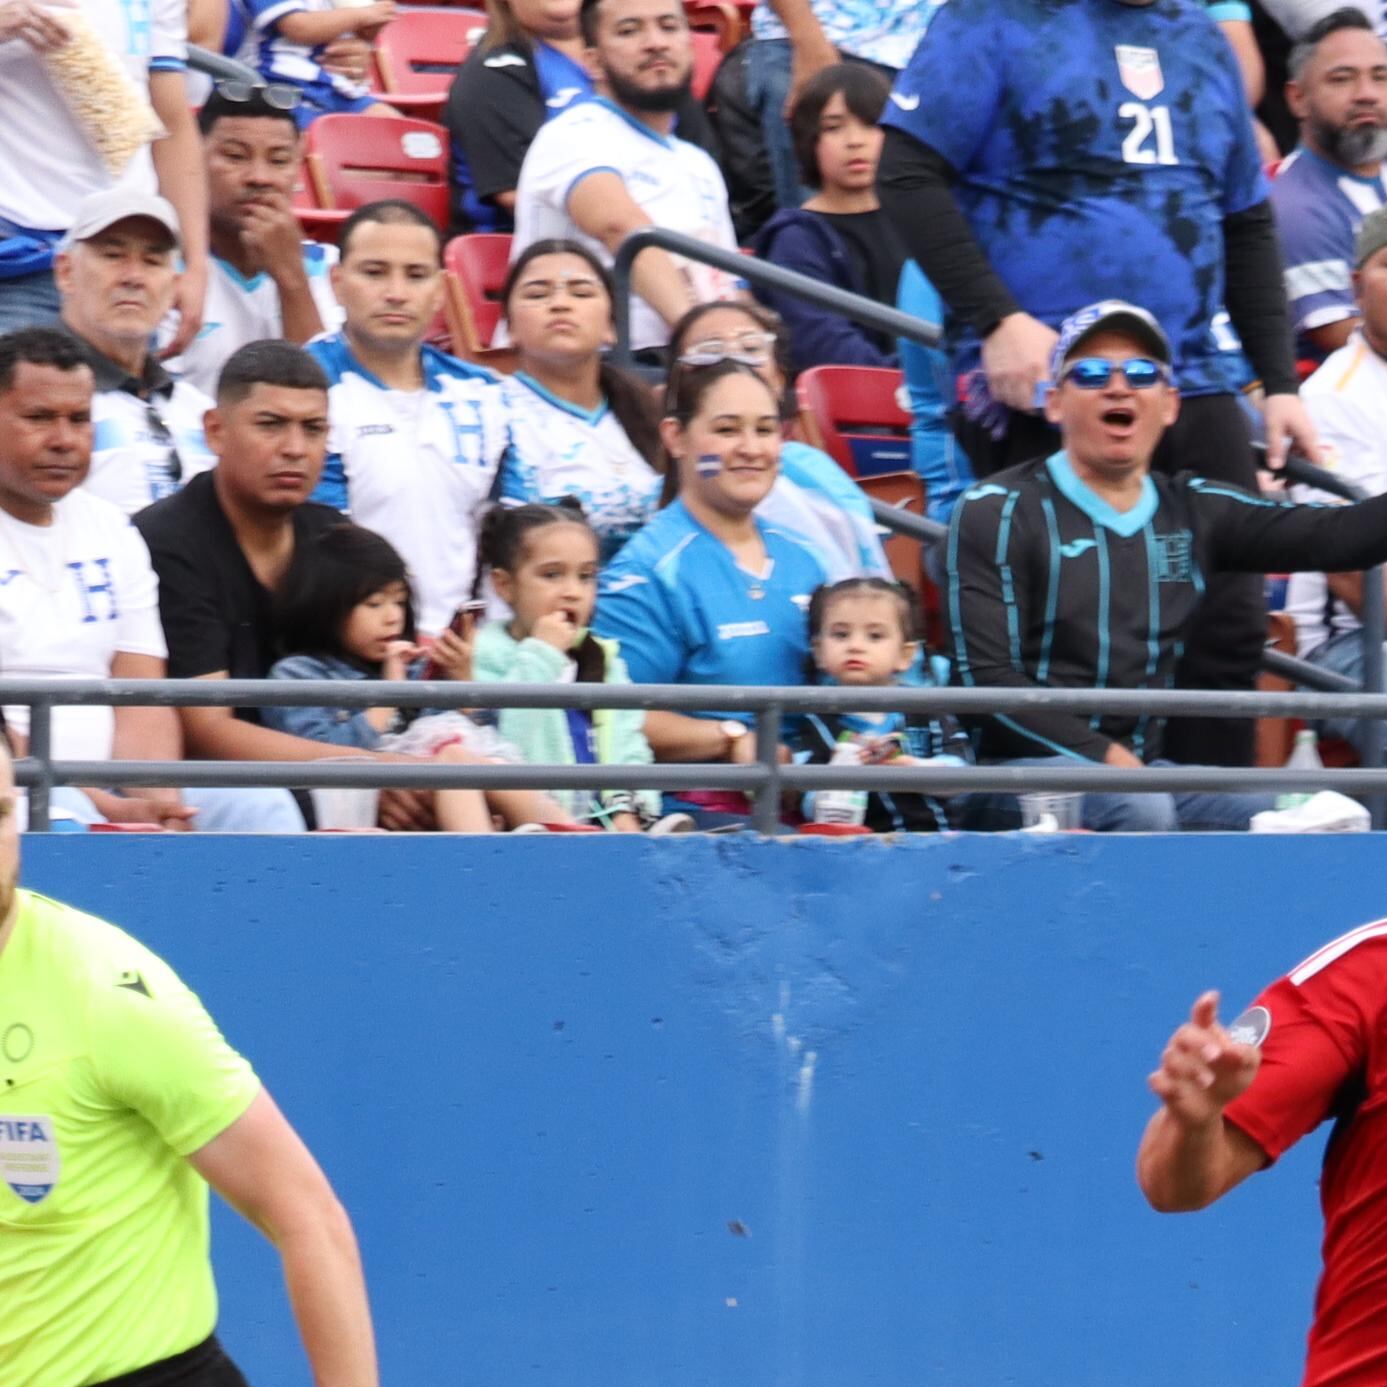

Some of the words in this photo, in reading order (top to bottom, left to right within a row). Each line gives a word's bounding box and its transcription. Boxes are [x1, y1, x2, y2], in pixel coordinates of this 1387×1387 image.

[1118, 102, 1180, 166] 21
[437, 399, 485, 466] H
[65, 557, 118, 622] H
